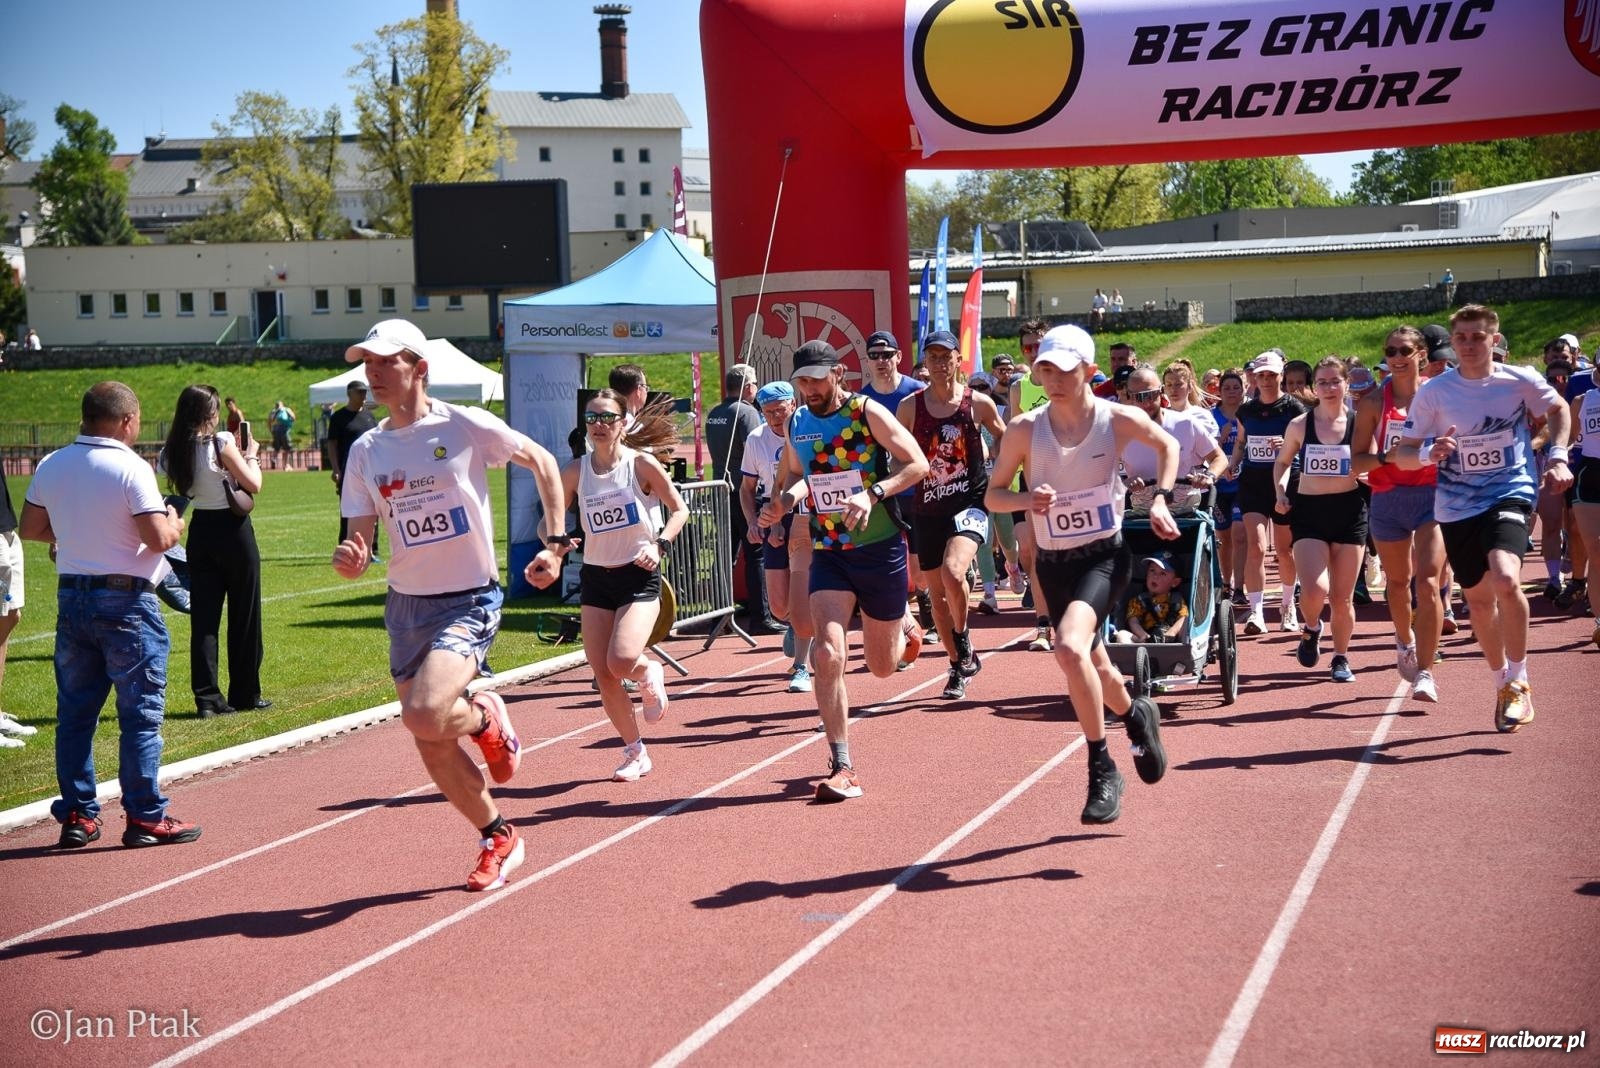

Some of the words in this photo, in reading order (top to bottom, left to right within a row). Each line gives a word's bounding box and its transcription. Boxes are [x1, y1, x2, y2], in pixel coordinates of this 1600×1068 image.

[995, 0, 1080, 30] SIR
[1128, 19, 1252, 66] BEZ
[1259, 0, 1495, 57] GRANIC
[1158, 64, 1463, 124] RACIBÓRZ
[521, 322, 608, 337] PersonalBest
[1251, 447, 1273, 457] 050
[1467, 450, 1501, 467] 033
[1310, 458, 1338, 471] 038
[924, 480, 970, 503] EXTREME
[406, 513, 449, 538] 043
[593, 507, 625, 527] 062
[1056, 510, 1093, 531] 051
